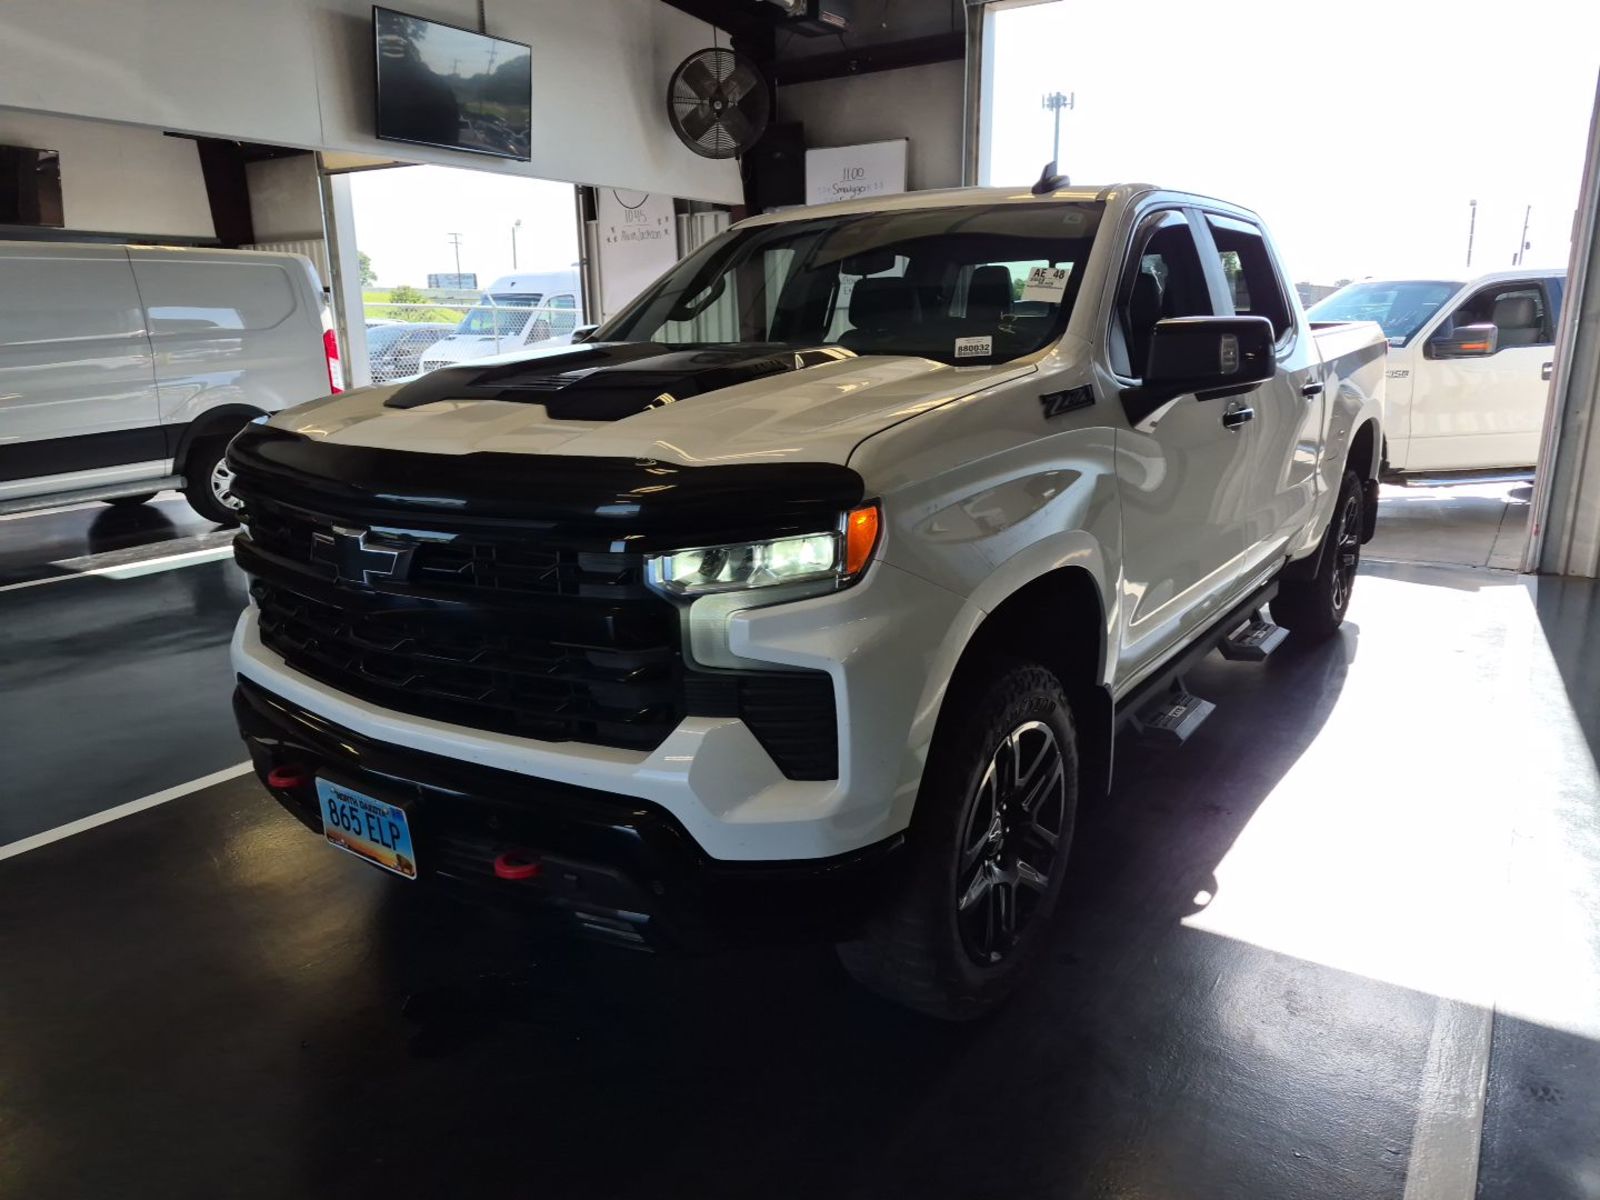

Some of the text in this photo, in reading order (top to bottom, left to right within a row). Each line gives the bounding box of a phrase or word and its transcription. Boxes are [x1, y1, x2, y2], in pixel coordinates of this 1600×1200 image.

[843, 167, 865, 180] 1100
[624, 209, 648, 223] 1045
[1033, 267, 1048, 278] AE
[1053, 269, 1066, 280] 48
[327, 798, 401, 851] 865 ELP
